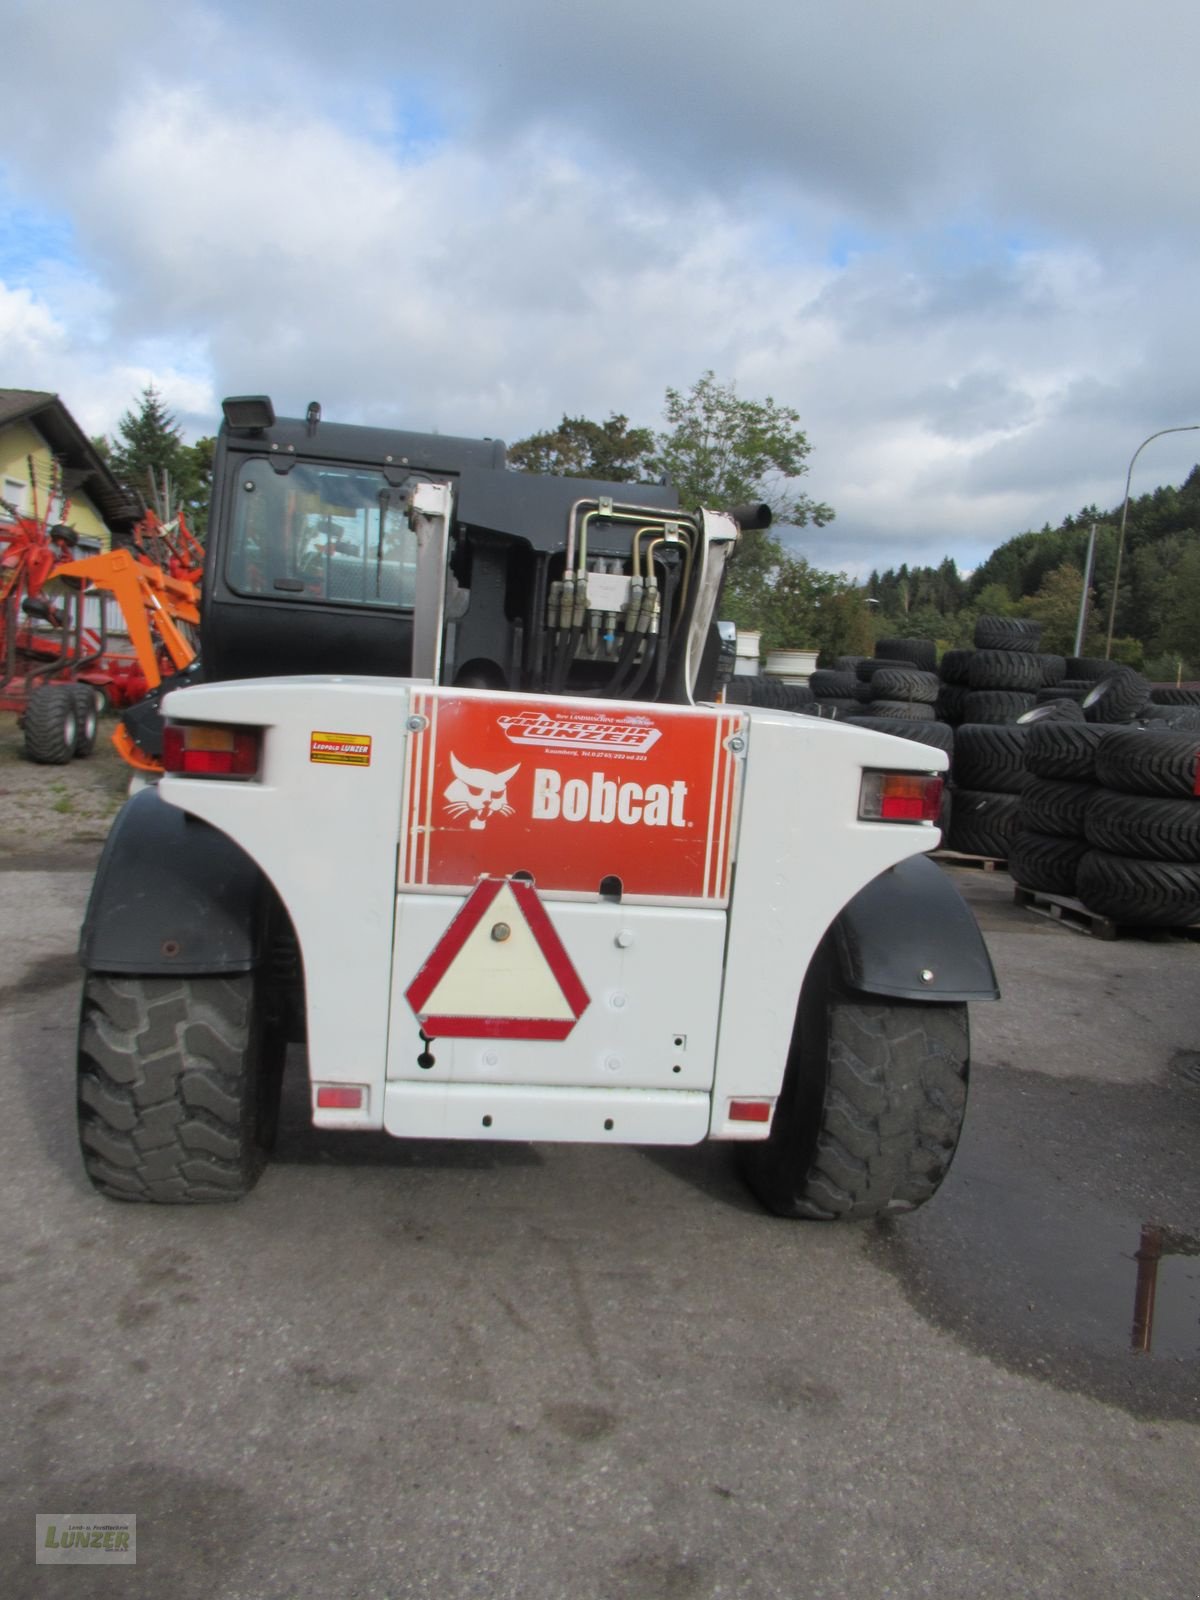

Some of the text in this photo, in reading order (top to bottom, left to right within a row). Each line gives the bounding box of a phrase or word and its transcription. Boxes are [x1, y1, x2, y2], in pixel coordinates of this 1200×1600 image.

[497, 715, 652, 735] LANDTECHNIK
[341, 744, 369, 753] LUNZER
[532, 768, 688, 828] Bobcat
